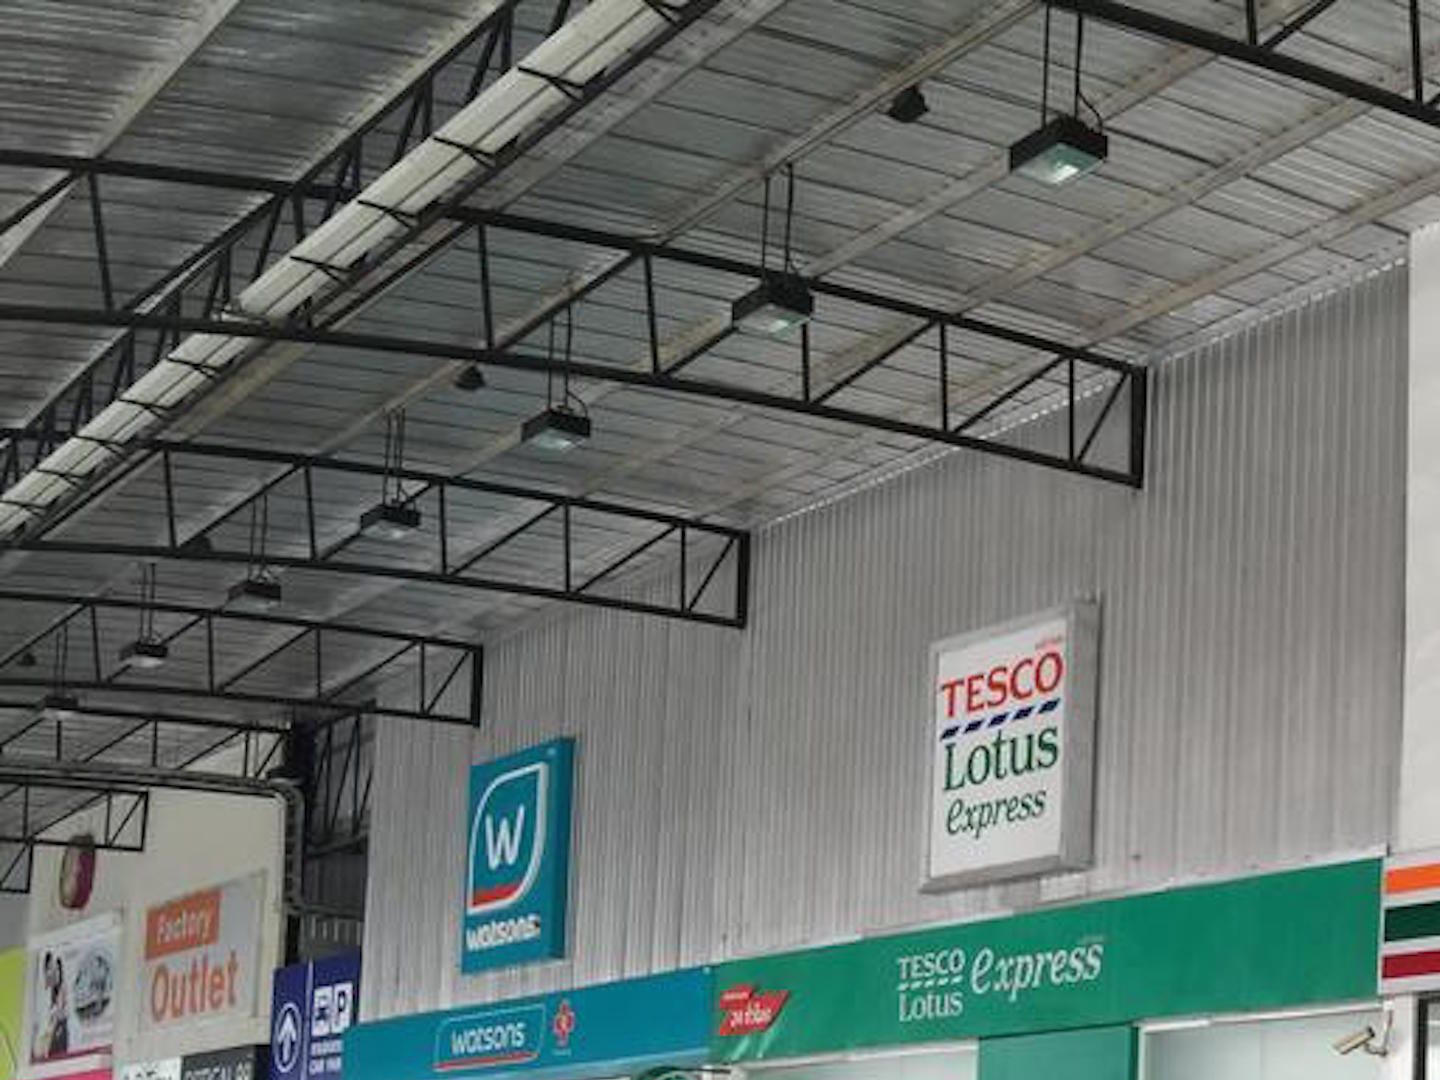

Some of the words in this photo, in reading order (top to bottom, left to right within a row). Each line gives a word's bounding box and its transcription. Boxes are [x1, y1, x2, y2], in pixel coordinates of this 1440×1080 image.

[940, 652, 1063, 718] TESCO
[943, 727, 1059, 791] Lotus
[946, 789, 1047, 840] express
[152, 950, 239, 1022] Outlet
[897, 947, 966, 979] TESCO
[970, 944, 1104, 1002] express
[899, 991, 964, 1022] Lotus
[451, 1022, 525, 1055] watsons
